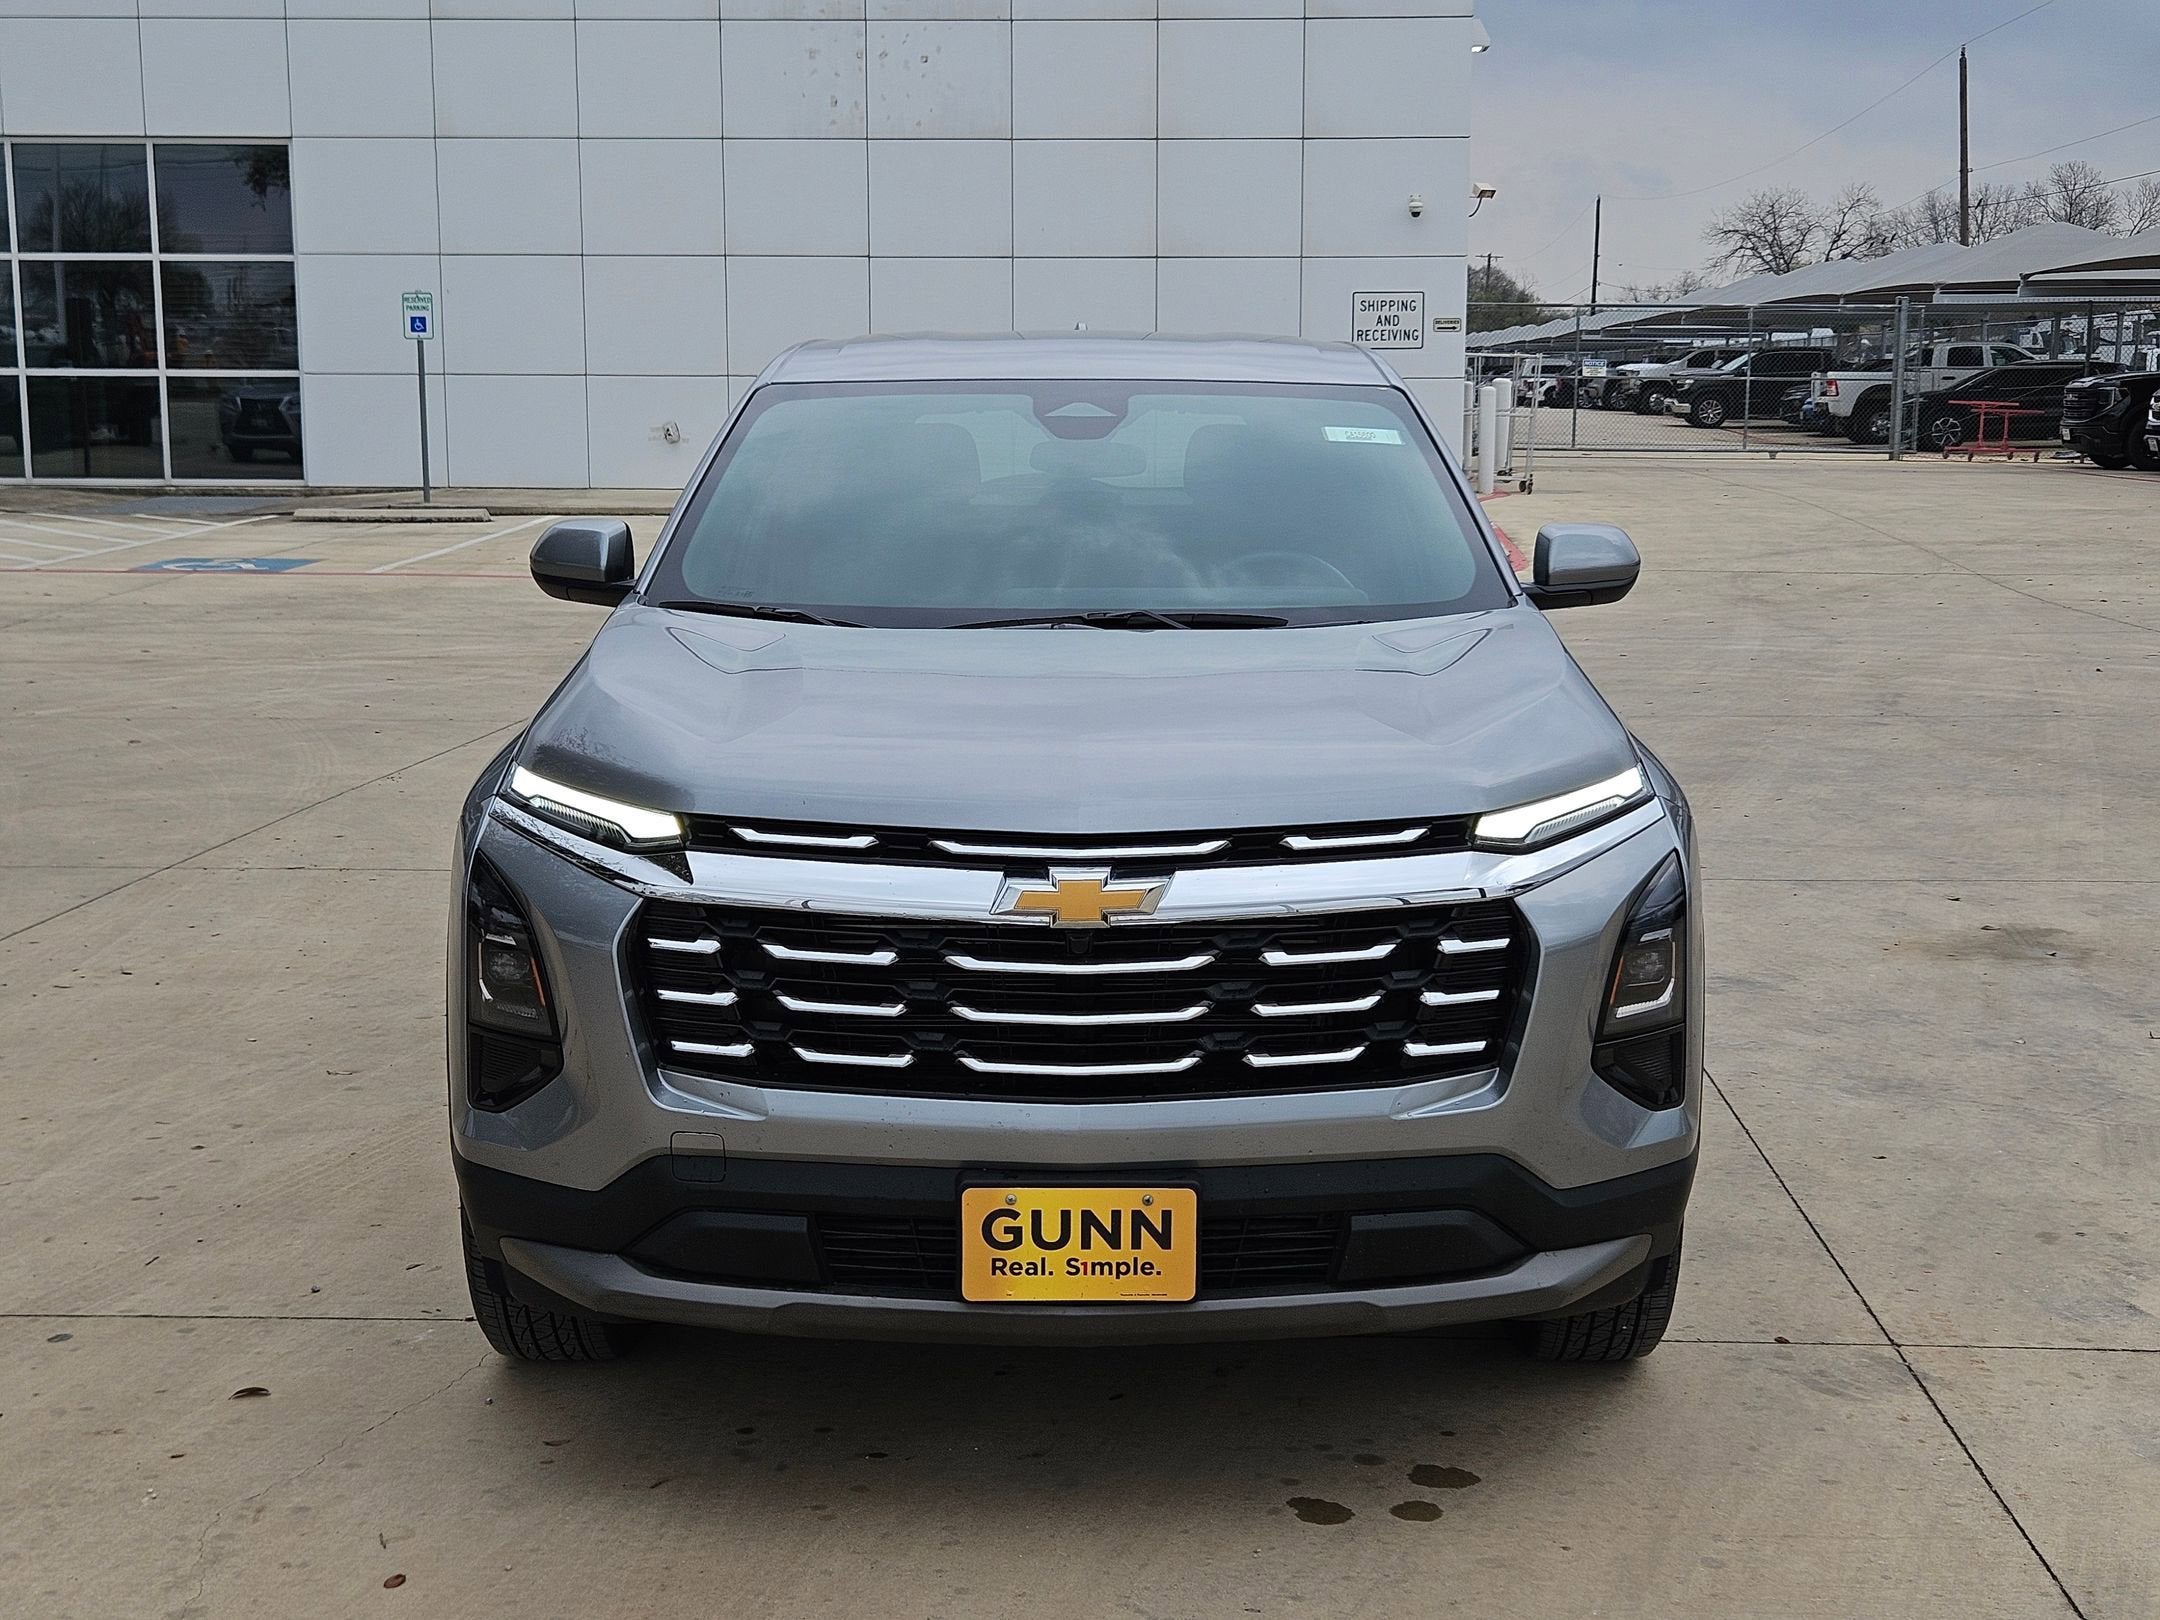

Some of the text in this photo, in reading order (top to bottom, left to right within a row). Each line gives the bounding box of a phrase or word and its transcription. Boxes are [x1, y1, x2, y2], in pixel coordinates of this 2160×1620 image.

[1359, 300, 1417, 312] SHIPPING
[1375, 314, 1400, 327] AND
[1356, 329, 1419, 341] RECEIVING
[981, 1208, 1172, 1251] GUNN
[991, 1257, 1054, 1277] Real.
